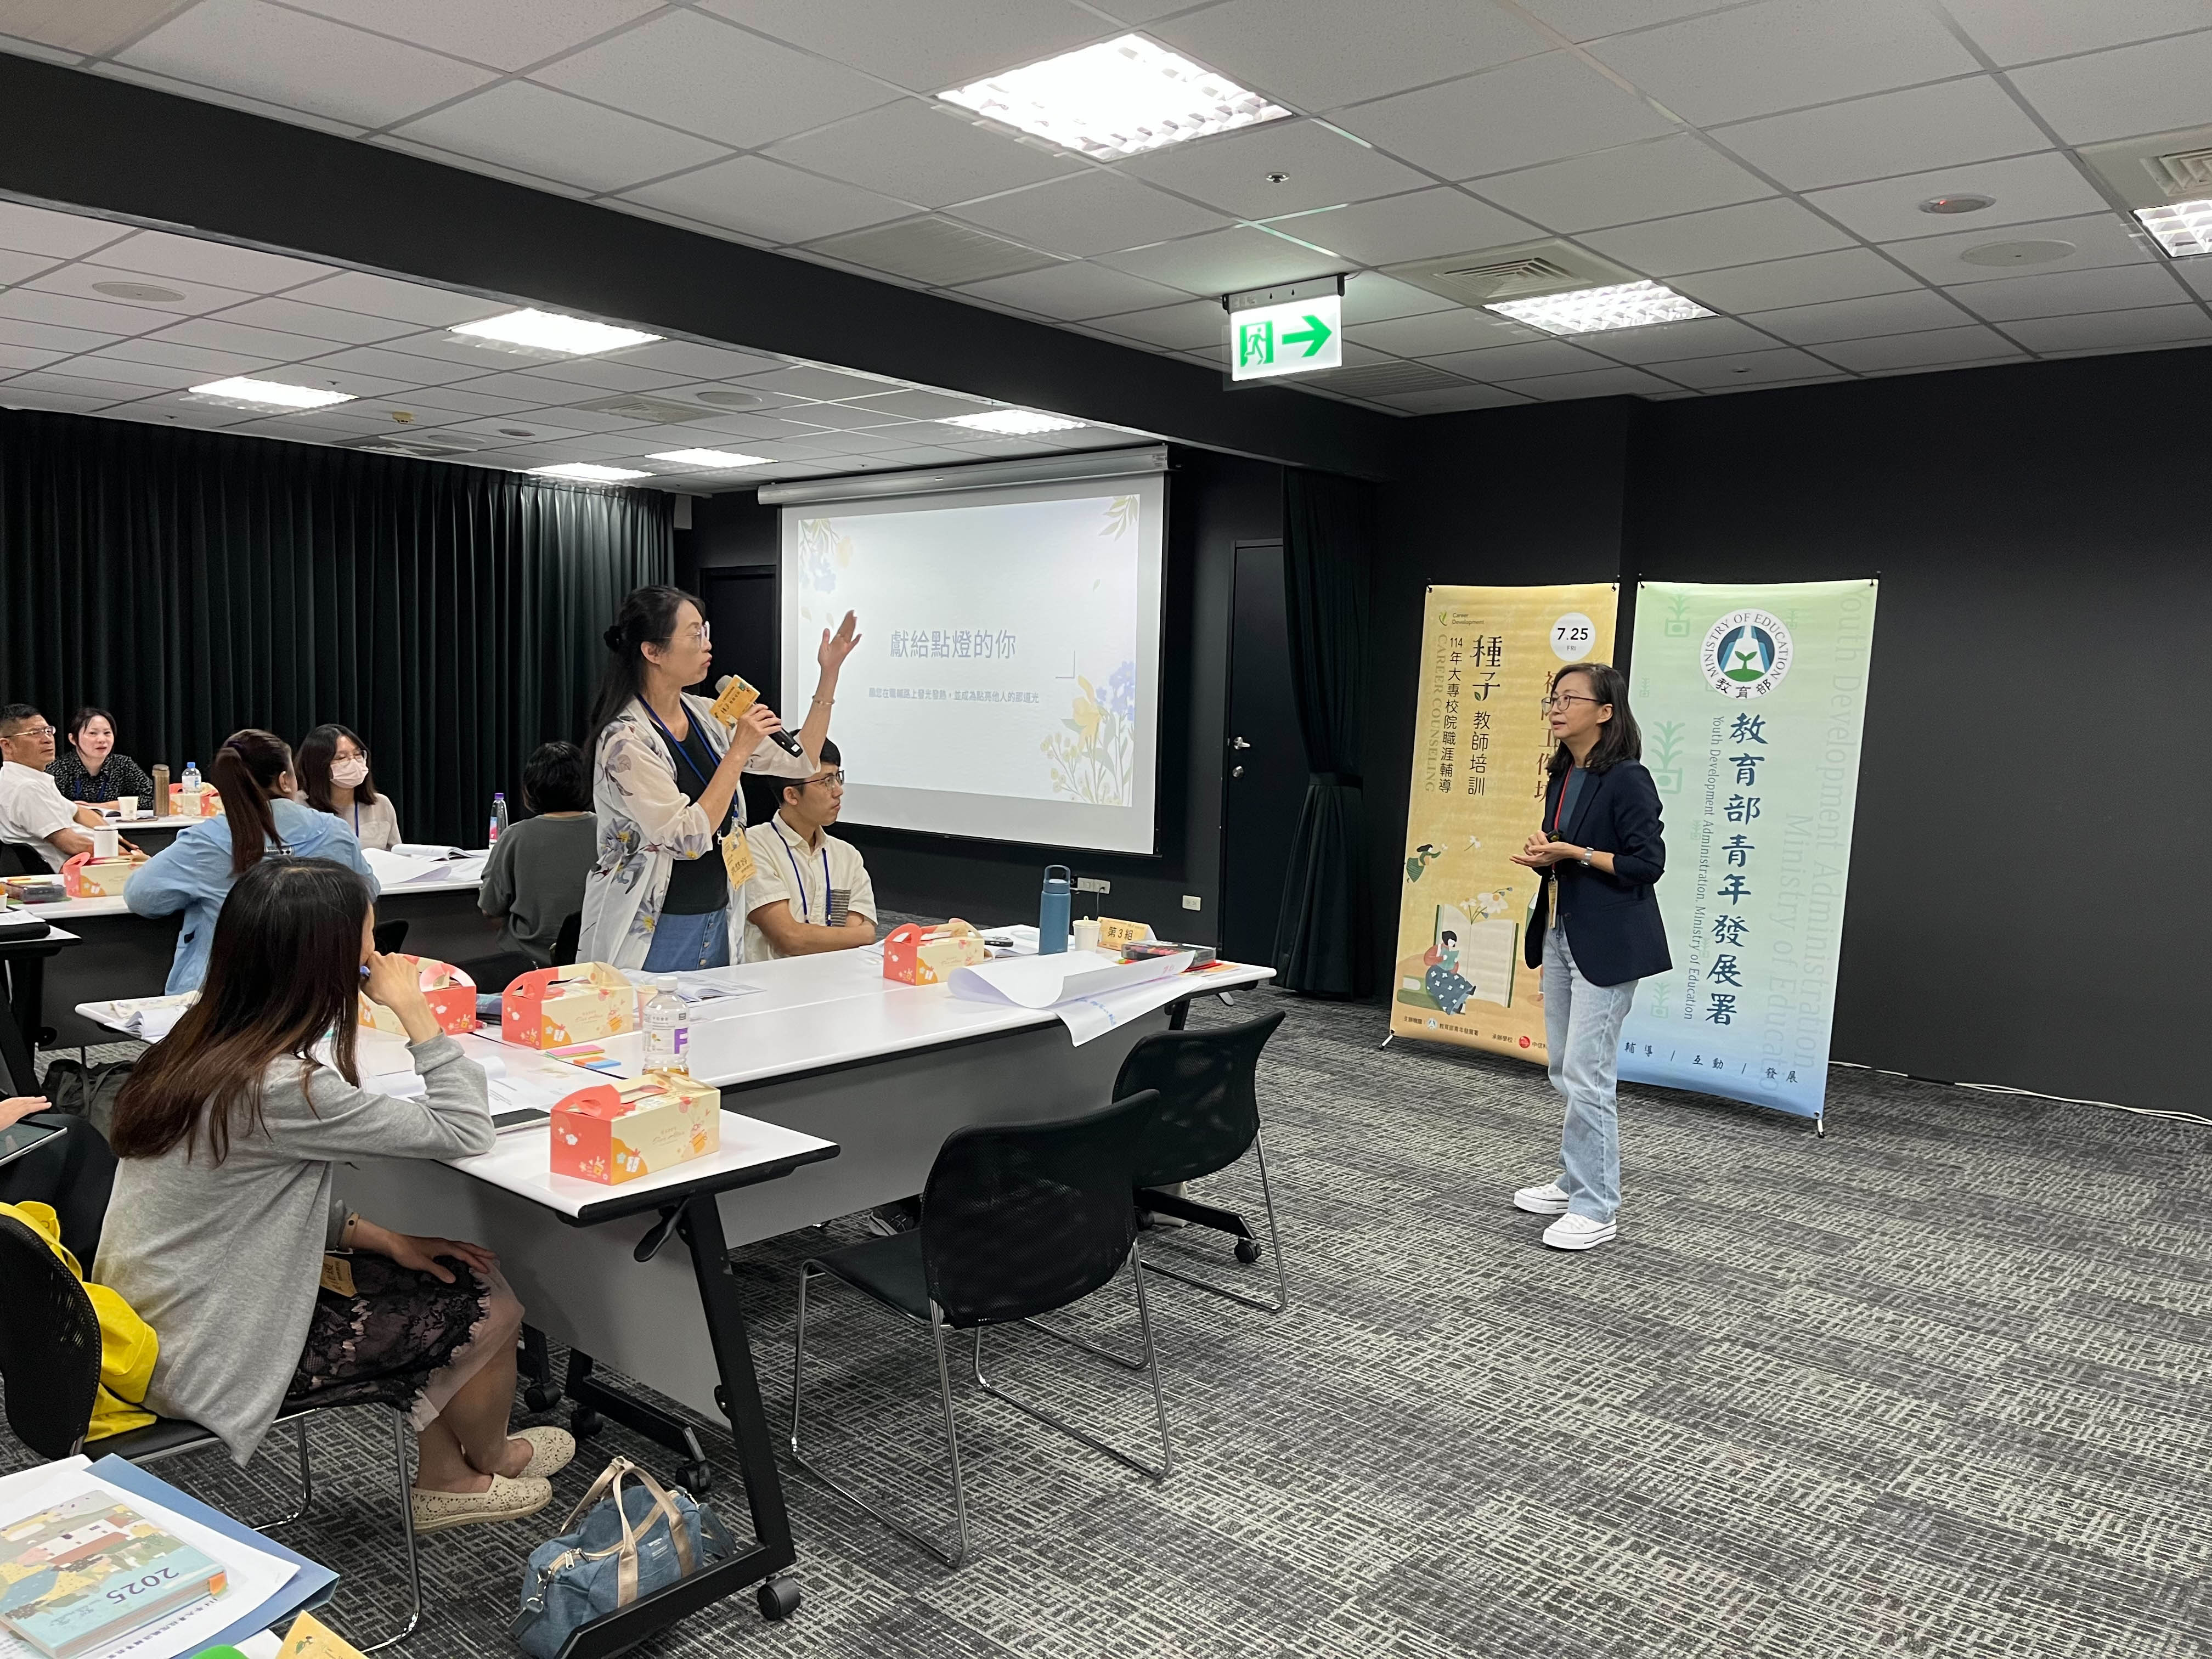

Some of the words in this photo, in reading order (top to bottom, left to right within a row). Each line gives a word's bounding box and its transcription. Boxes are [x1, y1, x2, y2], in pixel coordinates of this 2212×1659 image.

[890, 630, 1016, 658] 獻給點燈的你
[1557, 628, 1589, 641] 7.25
[1703, 619, 1730, 678] MINISTRY
[1734, 613, 1751, 624] OF
[1754, 613, 1788, 680] EDUCATION
[1835, 588, 1872, 662] Youth
[1432, 634, 1447, 693] CAREER
[1716, 678, 1771, 698] 教育部
[1425, 698, 1442, 792] COUNSELING
[1710, 715, 1724, 746] Youth
[1704, 749, 1722, 816] Development
[1815, 675, 1863, 850] Development
[1695, 820, 1714, 903] Administration,
[1705, 712, 1769, 1026] 教育部青年發展署
[1769, 812, 1814, 931] Ministry
[1689, 906, 1706, 952] Ministry
[1771, 939, 1798, 972] of
[1690, 953, 1701, 965] of
[1793, 860, 1843, 1069] Administration
[1684, 967, 1700, 1020] Education
[1624, 1041, 1653, 1057] 輔導
[1692, 1055, 1724, 1070] 互動
[1765, 1067, 1798, 1084] 發展
[105, 1567, 180, 1605] 2025
